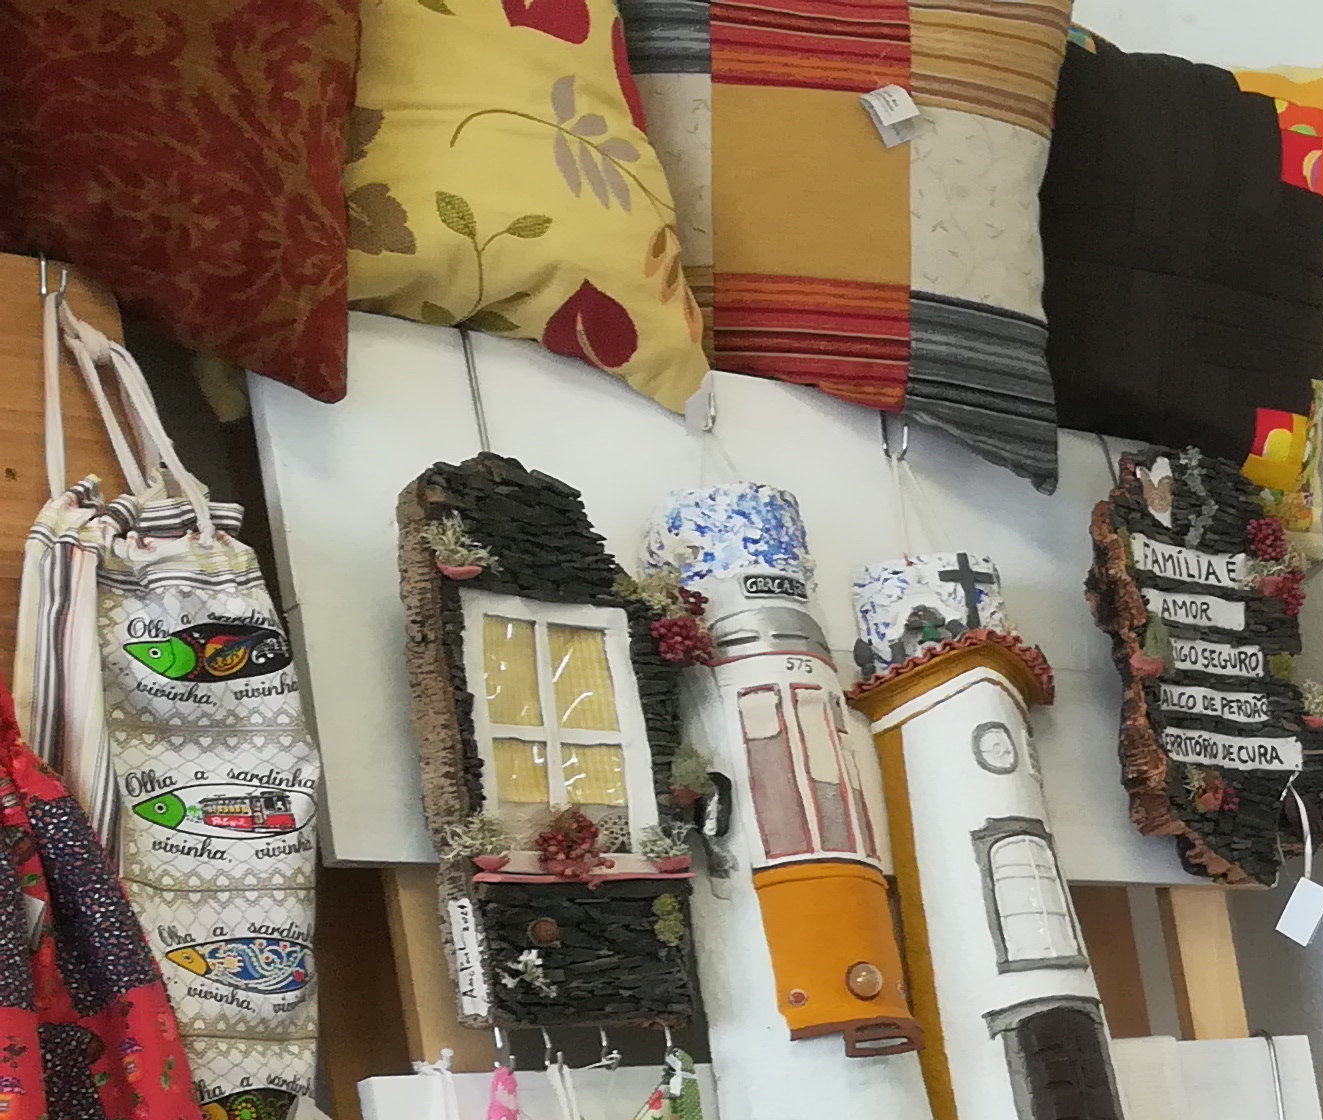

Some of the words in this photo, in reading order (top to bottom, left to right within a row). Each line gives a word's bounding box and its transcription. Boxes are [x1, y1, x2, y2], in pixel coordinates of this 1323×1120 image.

[1143, 541, 1222, 584] FAMÍLIA
[1161, 598, 1213, 622] AMOR
[127, 616, 171, 639] Olh
[181, 614, 192, 625] a
[785, 656, 813, 674] 575
[1160, 689, 1197, 711] ALCO
[1202, 694, 1219, 713] DE
[1221, 693, 1272, 720] PERDÃO
[1163, 732, 1218, 760] ERRITÓRIO
[1221, 743, 1236, 763] DE
[1237, 744, 1285, 766] CURA
[125, 769, 177, 798] Olha
[194, 770, 209, 781] a
[227, 768, 316, 790] sardinha
[157, 924, 196, 947] Olha
[213, 926, 228, 937] a
[239, 1076, 253, 1088] a
